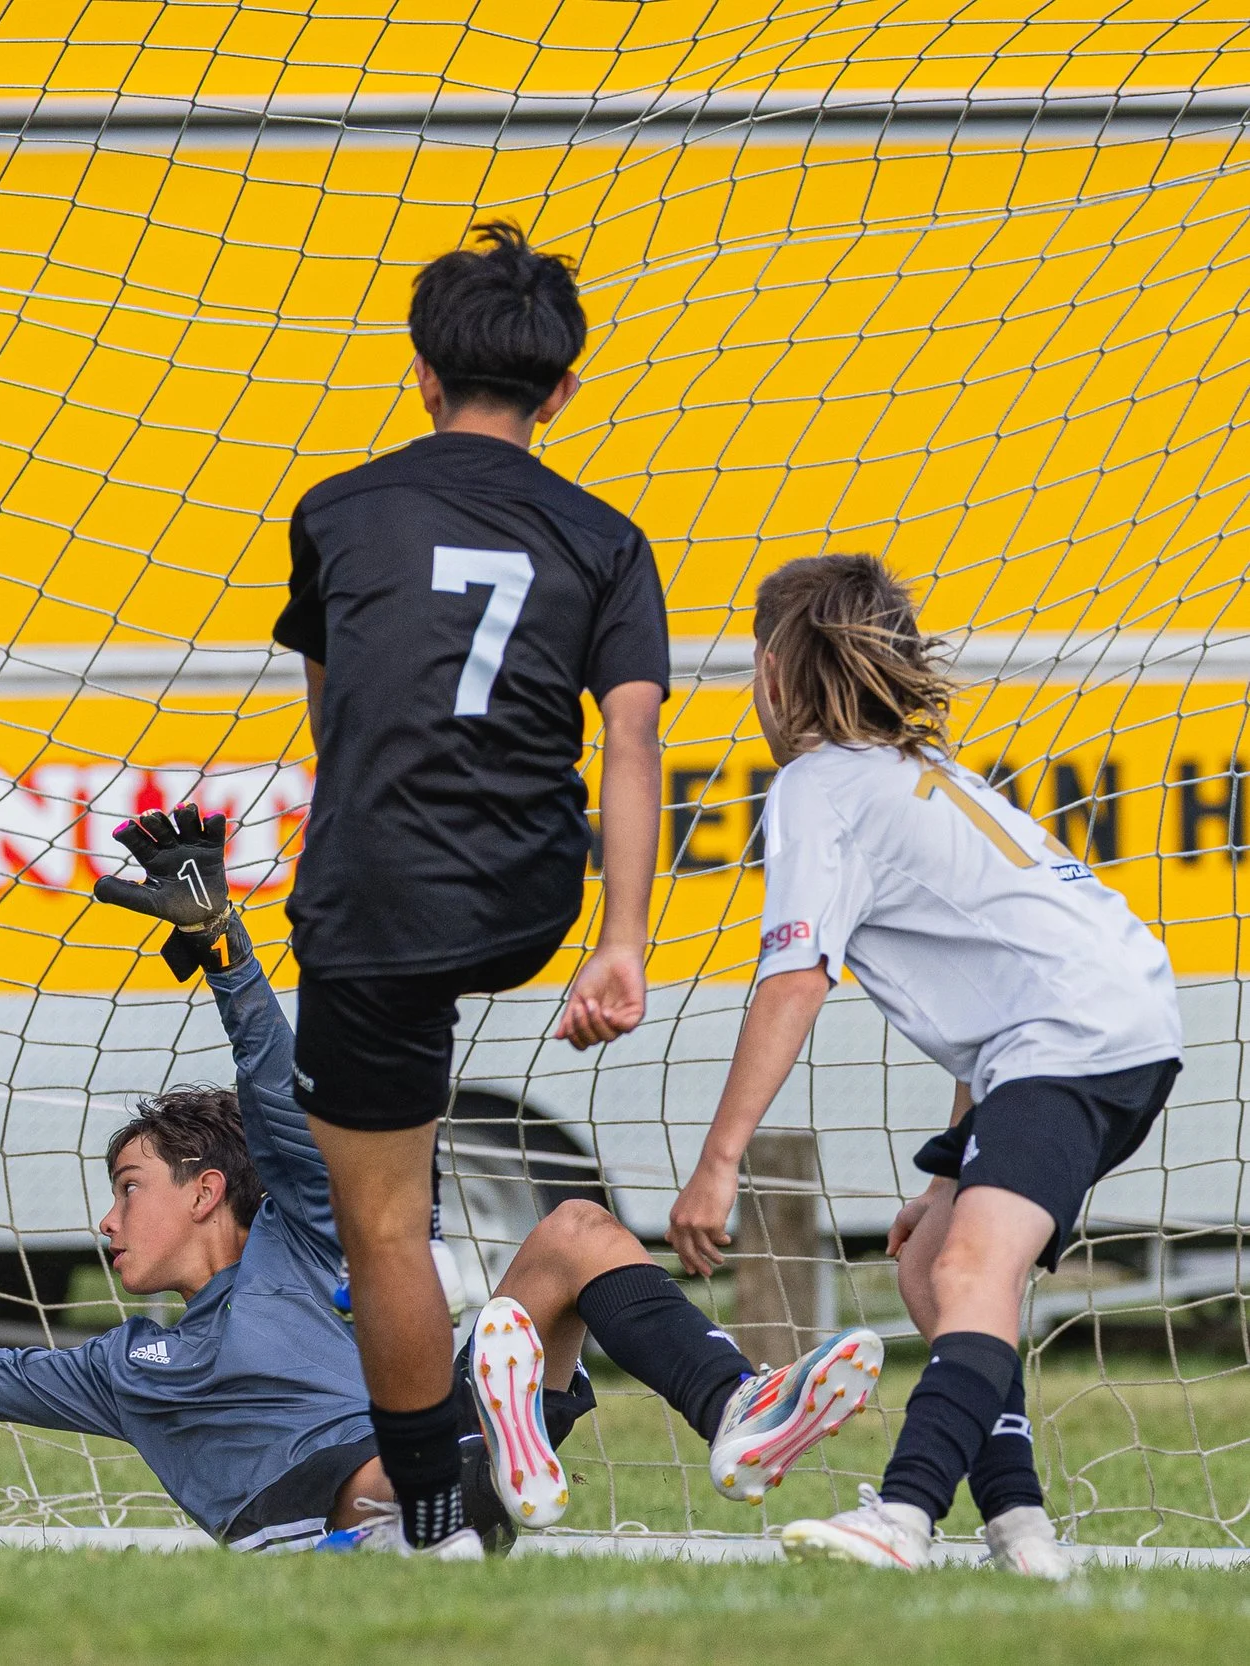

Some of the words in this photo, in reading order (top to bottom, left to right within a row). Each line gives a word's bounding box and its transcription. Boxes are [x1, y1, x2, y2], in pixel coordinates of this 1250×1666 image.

[432, 546, 534, 717] 7
[177, 858, 213, 911] 1
[210, 932, 231, 967] 1
[130, 1350, 171, 1364] adidas
